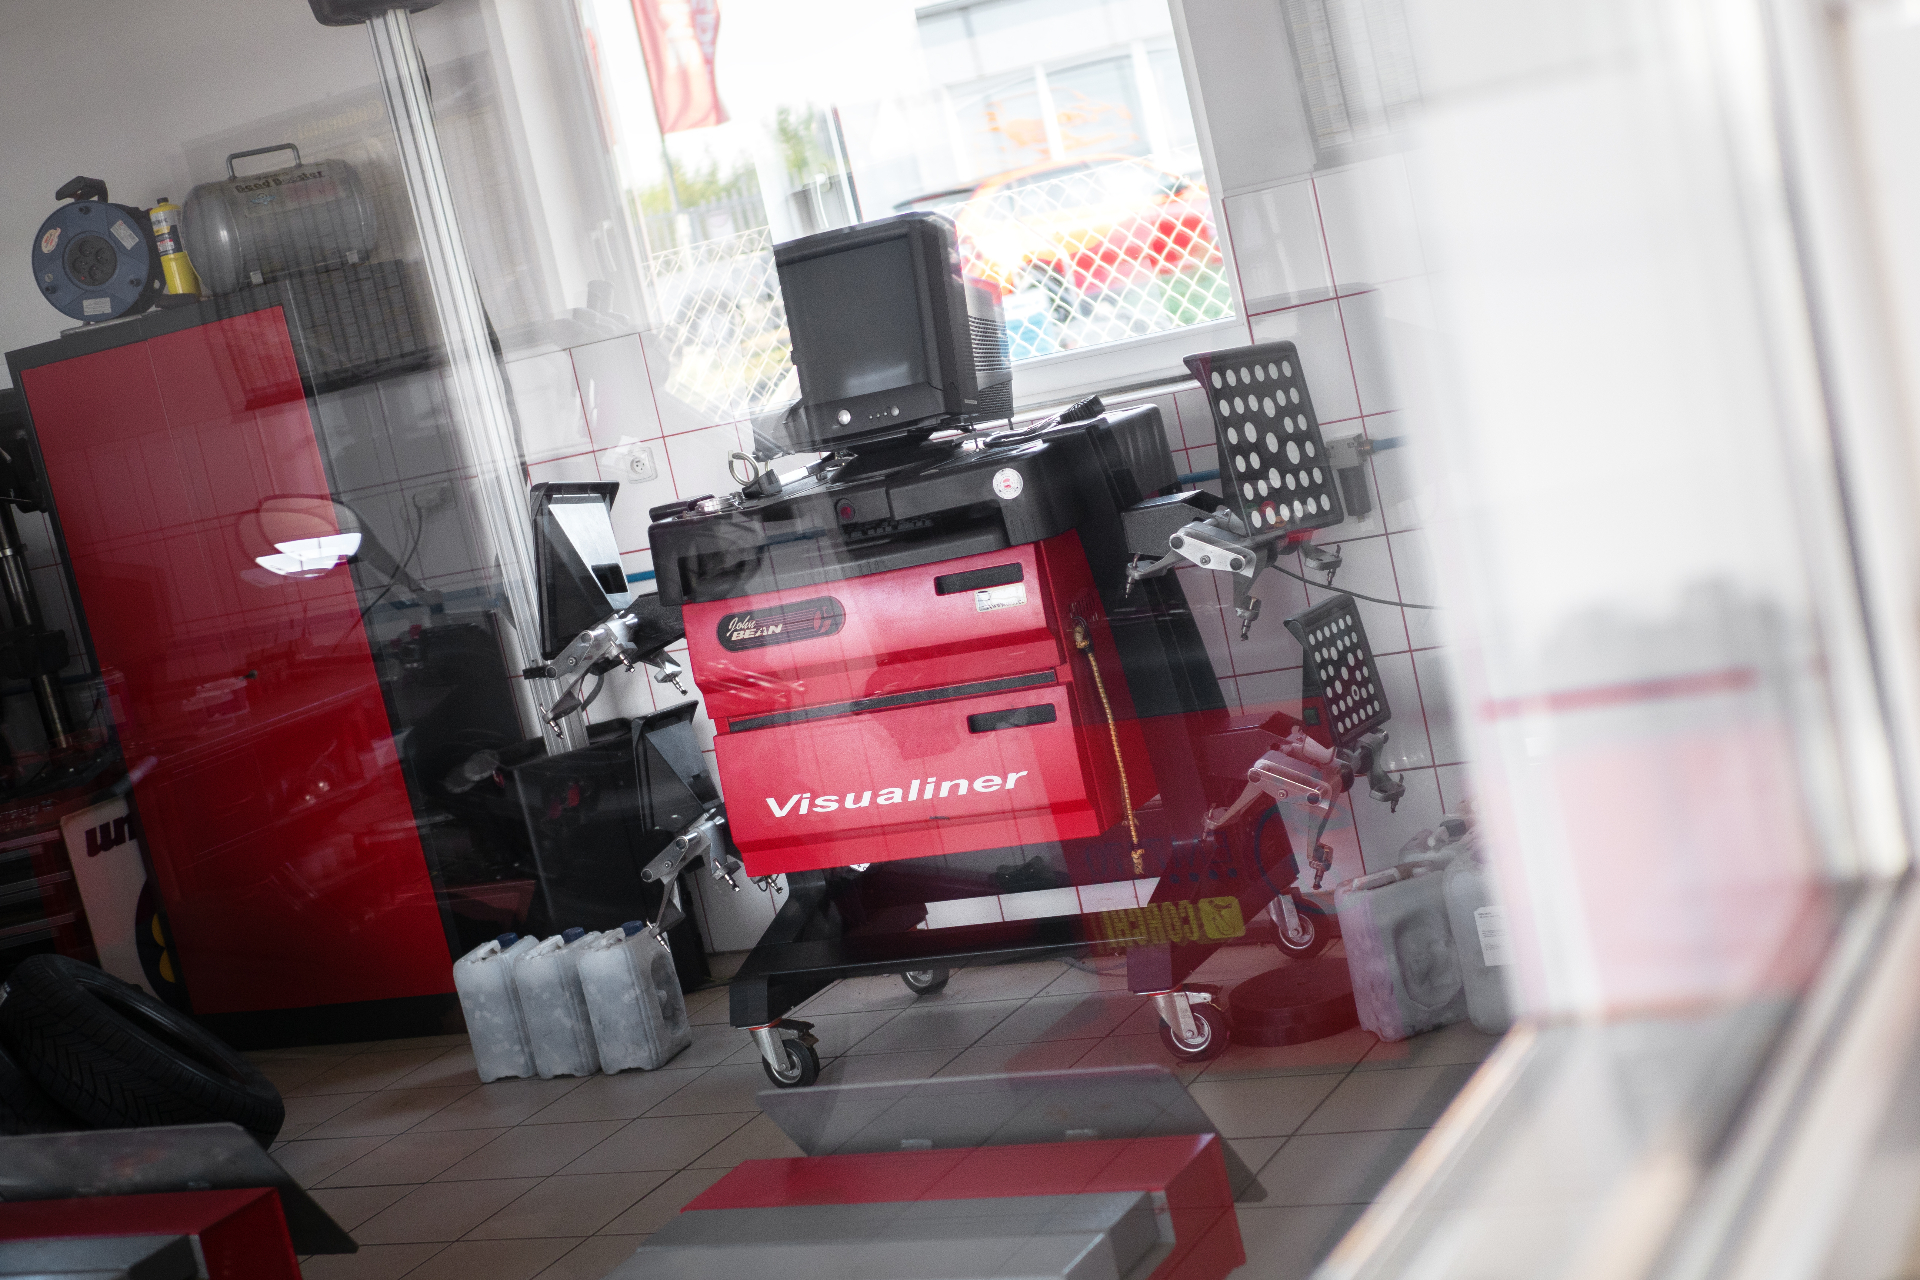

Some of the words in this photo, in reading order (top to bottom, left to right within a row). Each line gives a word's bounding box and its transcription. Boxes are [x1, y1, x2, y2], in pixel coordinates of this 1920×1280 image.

[272, 170, 325, 187] Boster
[727, 615, 757, 637] John
[730, 624, 783, 641] BEAN
[766, 770, 1029, 819] Visualiner
